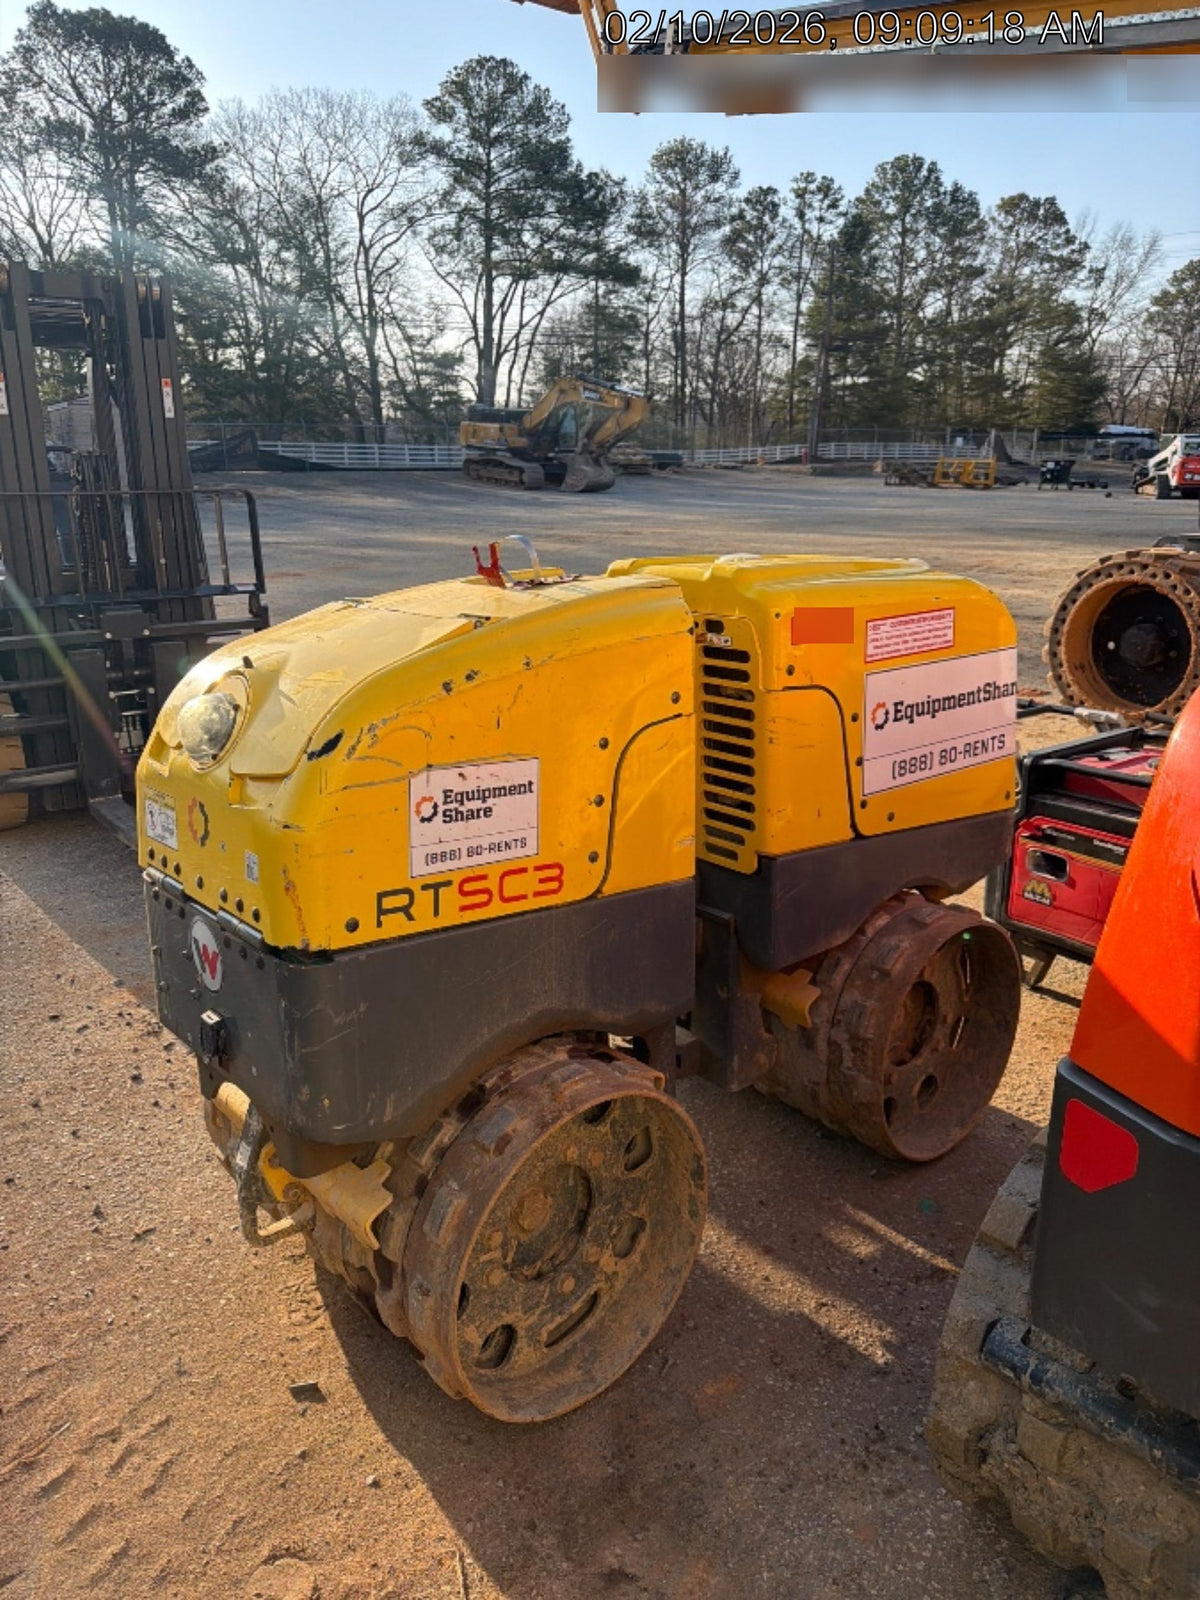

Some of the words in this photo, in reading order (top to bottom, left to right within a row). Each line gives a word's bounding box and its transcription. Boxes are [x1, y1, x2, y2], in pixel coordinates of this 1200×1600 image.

[892, 681, 1018, 724] EquipmentShar
[892, 751, 933, 780] (888)
[939, 733, 1006, 766] 80-RENTS
[442, 780, 534, 806] Equipment
[442, 806, 493, 824] Share
[425, 849, 462, 867] (888)
[466, 838, 527, 858] 80-RENTS
